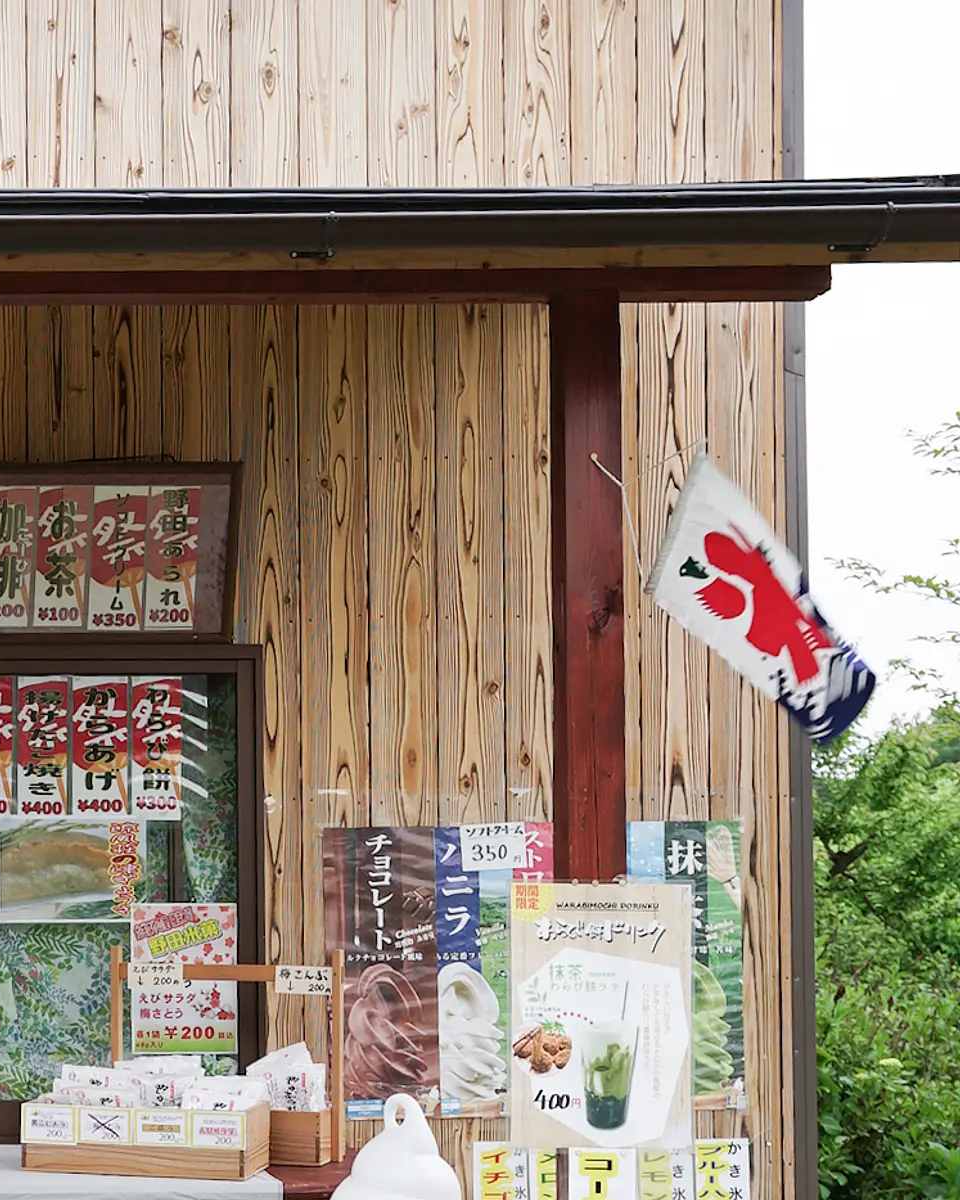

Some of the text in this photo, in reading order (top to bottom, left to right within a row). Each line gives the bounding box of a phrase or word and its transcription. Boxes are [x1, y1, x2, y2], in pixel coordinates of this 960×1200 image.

[43, 500, 78, 599] お茶
[109, 493, 131, 612] ソフトクリーム
[159, 488, 189, 607] 野田あられ
[38, 607, 80, 622] ¥100
[92, 612, 136, 627] ¥350
[149, 608, 190, 623] ¥200
[84, 687, 120, 791] からあげ
[141, 683, 171, 791] わらび餅
[21, 801, 62, 816] ¥400
[77, 799, 123, 813] ¥400
[136, 795, 177, 811] ¥300
[471, 843, 508, 862] 350
[365, 833, 393, 951] チョコレート
[515, 884, 540, 897] 期間
[515, 897, 540, 910] 限定
[164, 1026, 215, 1040] ¥200
[534, 1089, 571, 1110] 400
